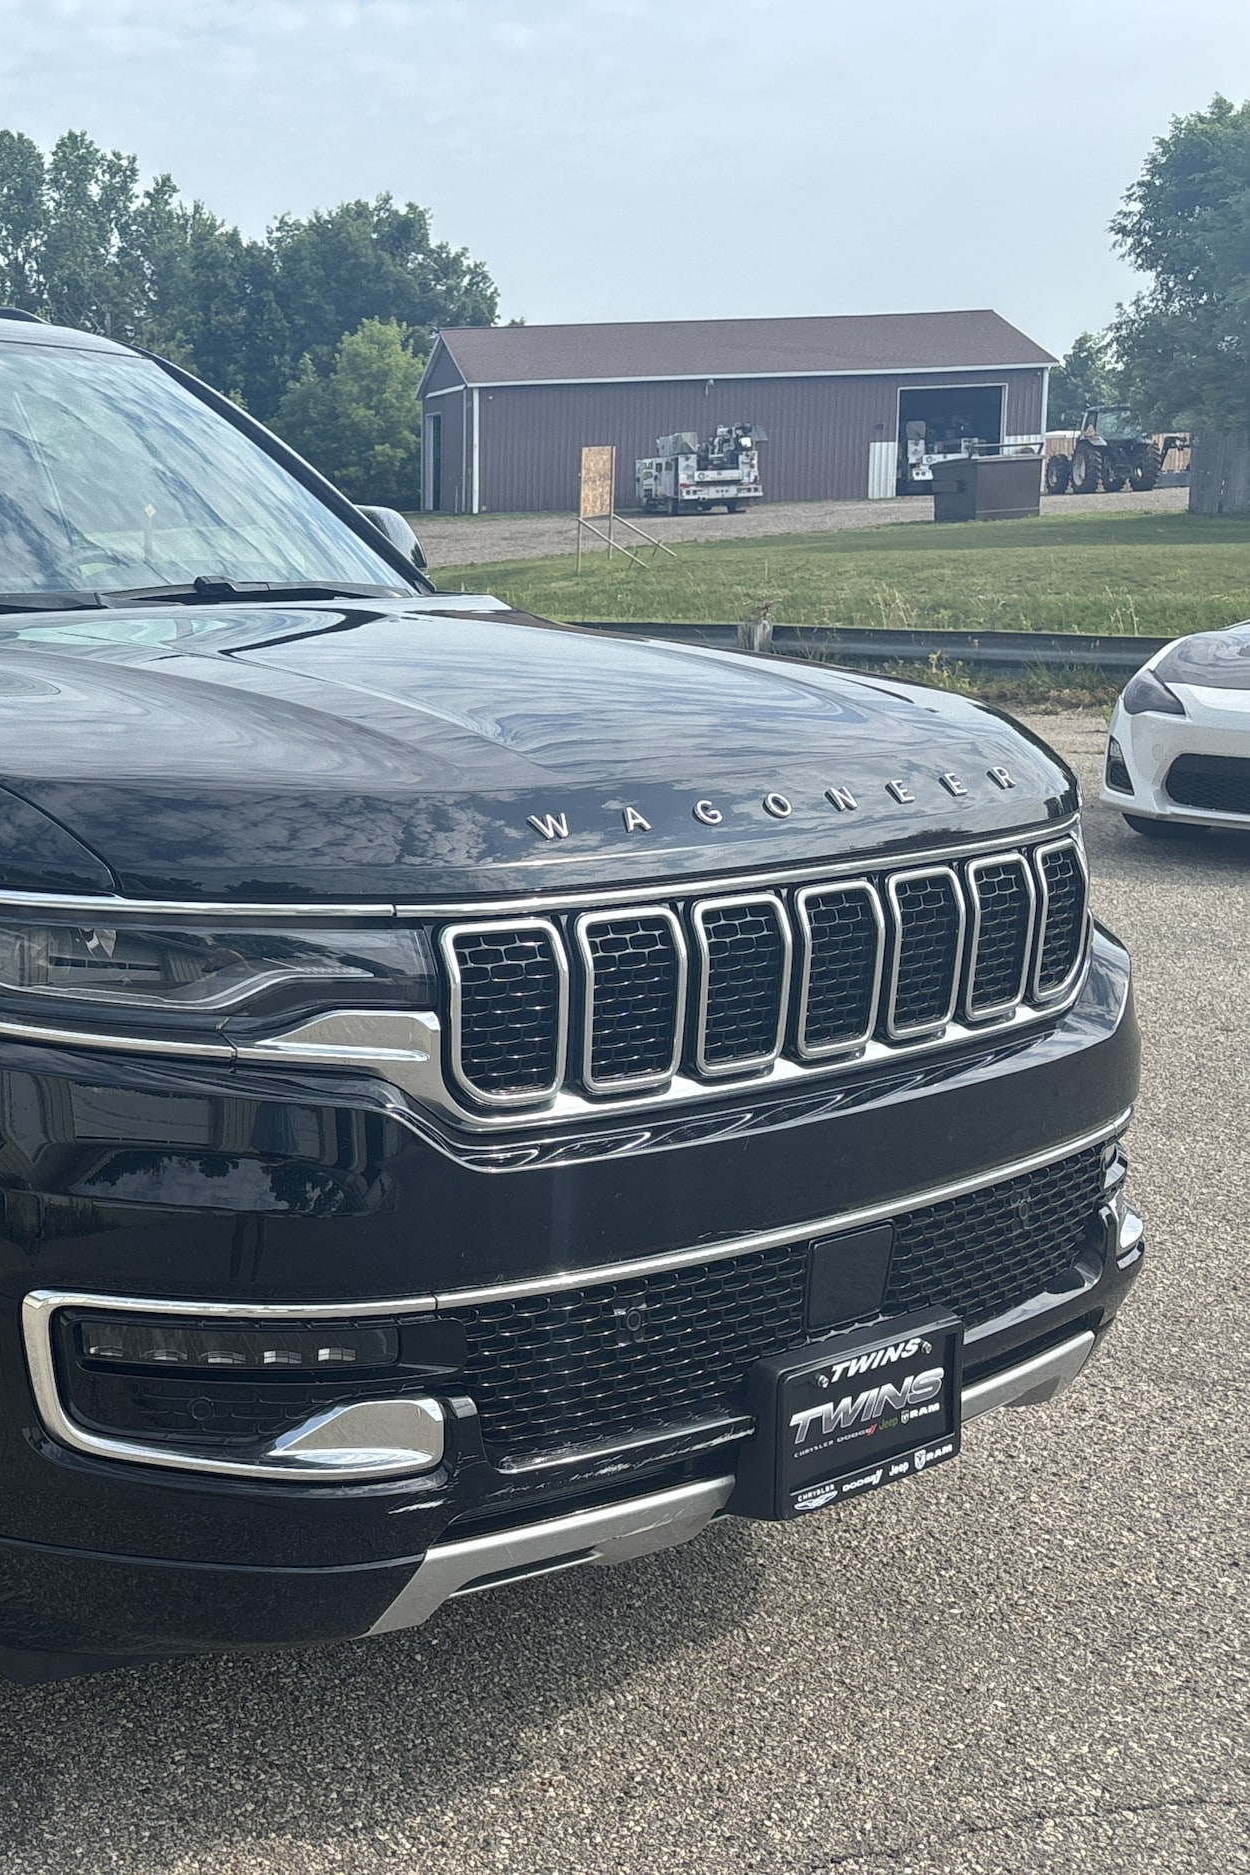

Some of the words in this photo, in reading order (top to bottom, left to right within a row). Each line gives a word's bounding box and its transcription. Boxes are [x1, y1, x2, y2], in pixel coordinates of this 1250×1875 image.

[527, 765, 1016, 840] WAGONEER
[831, 1338, 922, 1383] TWINS
[789, 1367, 944, 1444] TWINS
[794, 1440, 834, 1458] CHRYSLER
[879, 1416, 898, 1430] Jeep
[909, 1402, 940, 1419] RAM
[798, 1484, 835, 1502] CHRYSLER
[889, 1462, 909, 1476] Jeep
[926, 1444, 953, 1461] RAM
